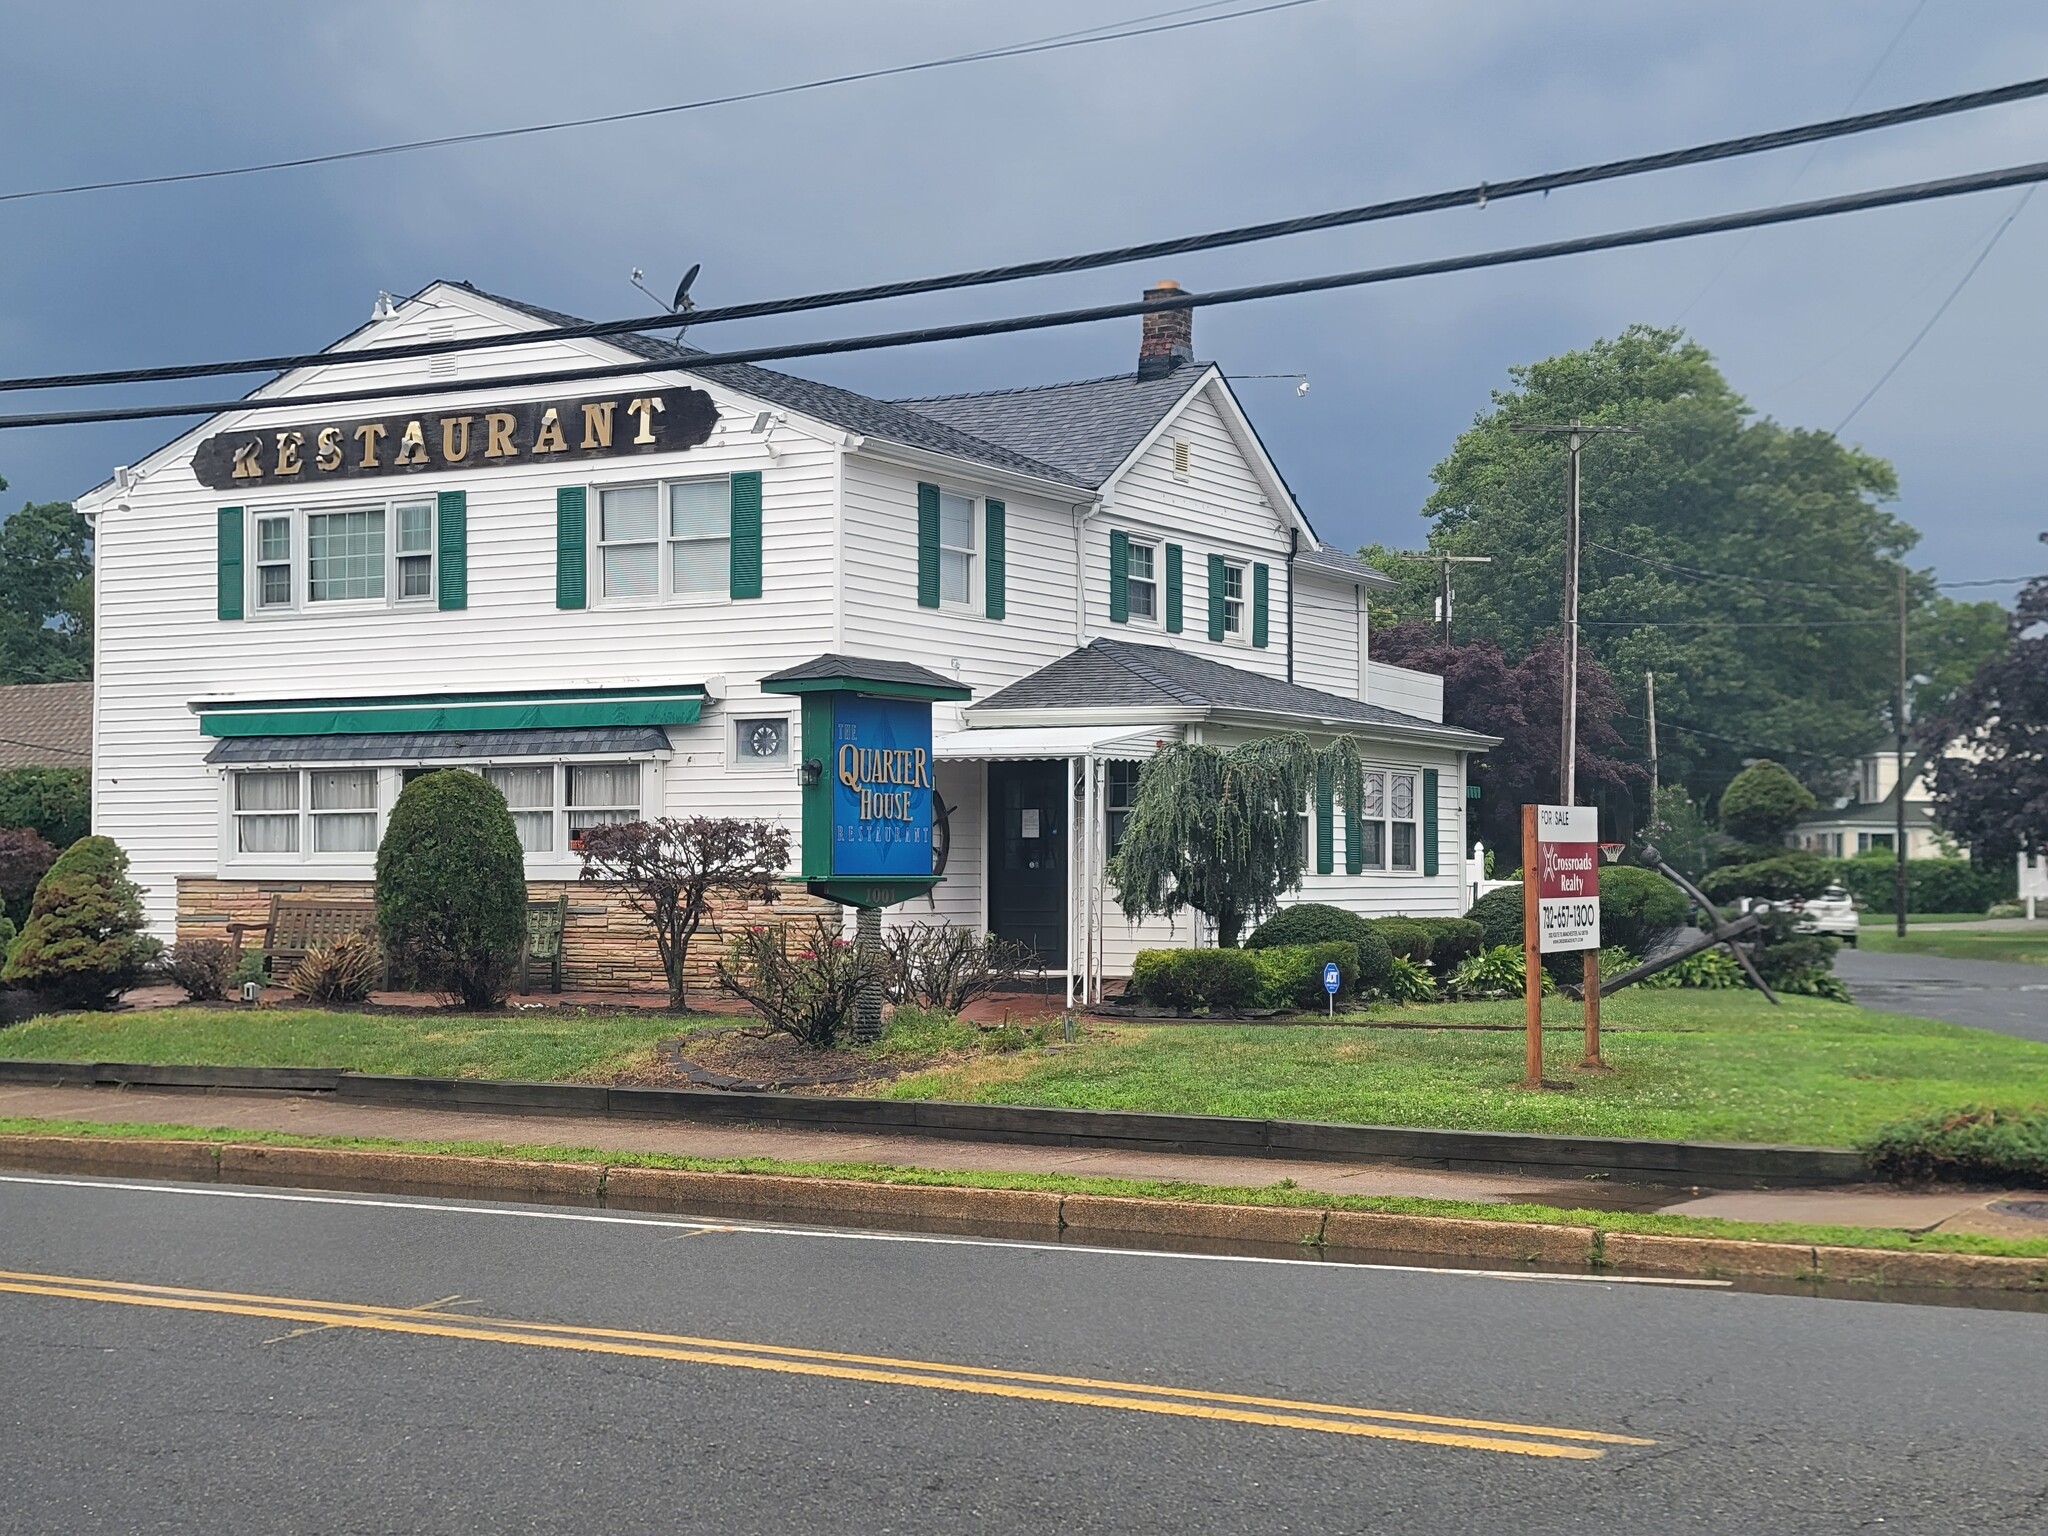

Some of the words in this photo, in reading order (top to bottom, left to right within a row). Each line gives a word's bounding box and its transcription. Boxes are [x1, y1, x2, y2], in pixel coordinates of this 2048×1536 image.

[231, 398, 667, 478] RESTAURANT
[838, 723, 858, 740] THE
[838, 743, 930, 792] QUARTER
[859, 789, 914, 821] HOUSE
[1541, 810, 1552, 825] FOR
[1555, 811, 1569, 826] SALE
[837, 825, 929, 843] RESTAURANT
[1552, 853, 1592, 871] Crossroads
[1561, 873, 1584, 896] Realty
[865, 887, 896, 904] 1001
[1543, 904, 1595, 929] 732-657-1300
